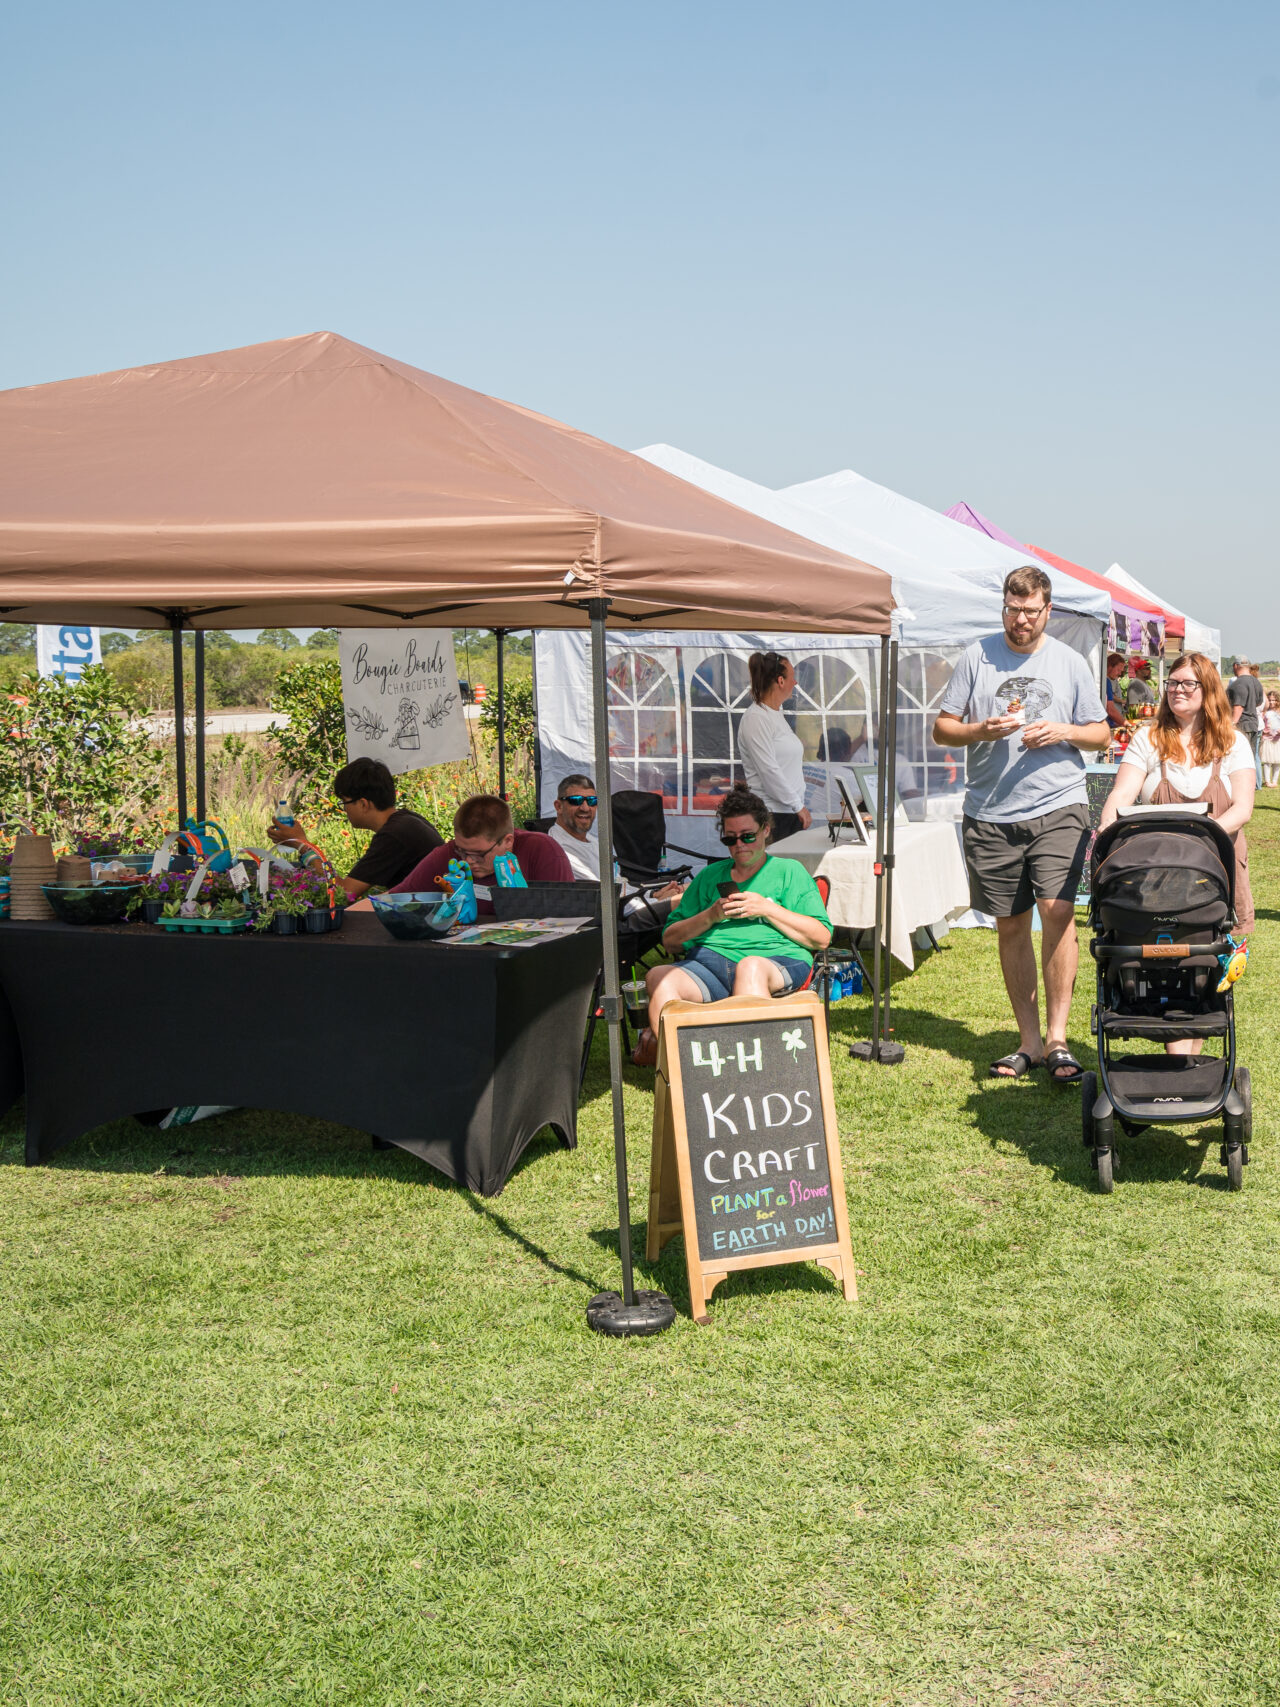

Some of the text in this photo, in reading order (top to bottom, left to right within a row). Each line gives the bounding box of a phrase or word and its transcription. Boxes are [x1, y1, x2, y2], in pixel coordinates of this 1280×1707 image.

[352, 638, 447, 694] Bougie Boards
[387, 677, 447, 695] CHARCUTERIE
[690, 1038, 763, 1077] 4-H
[702, 1090, 813, 1138] KIDS
[703, 1142, 820, 1185] CRAFT
[710, 1179, 829, 1215] PLANT a flower
[756, 1208, 776, 1220] for
[713, 1208, 834, 1251] EARTH DAY!
